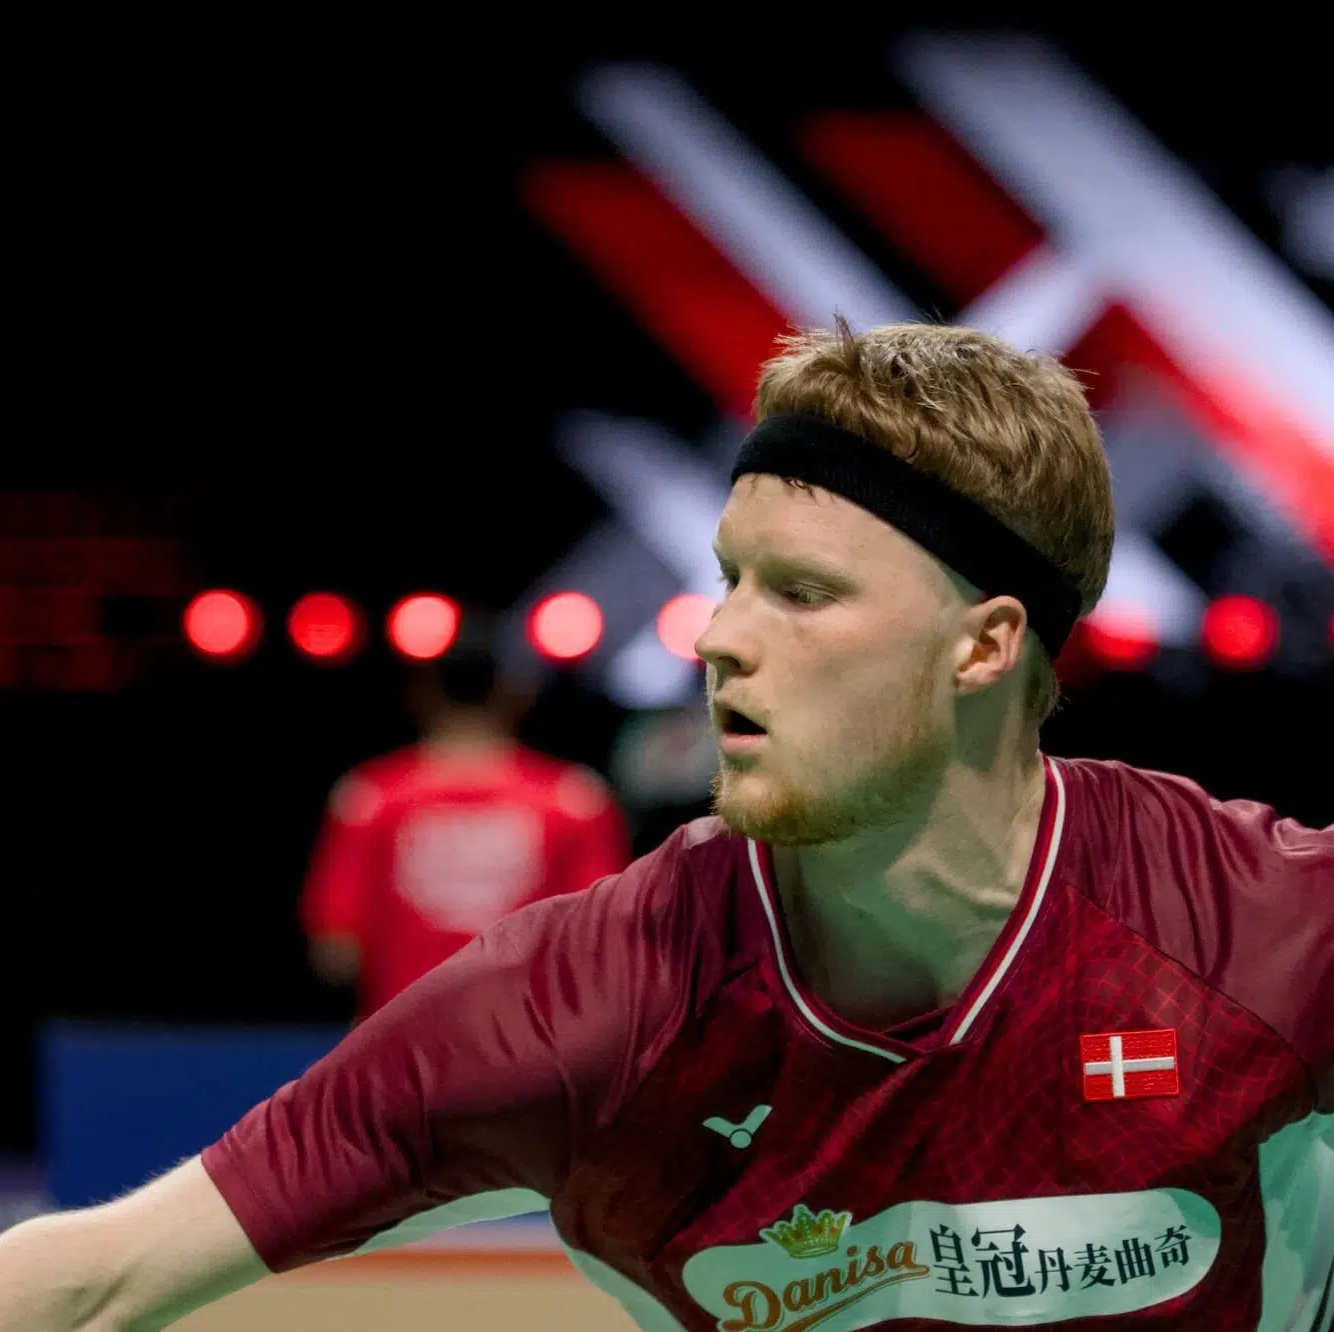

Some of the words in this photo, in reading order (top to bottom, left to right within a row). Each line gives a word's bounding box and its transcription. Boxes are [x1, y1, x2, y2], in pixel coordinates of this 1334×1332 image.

[929, 1223, 1193, 1299] 皇冠丹麦曲奇
